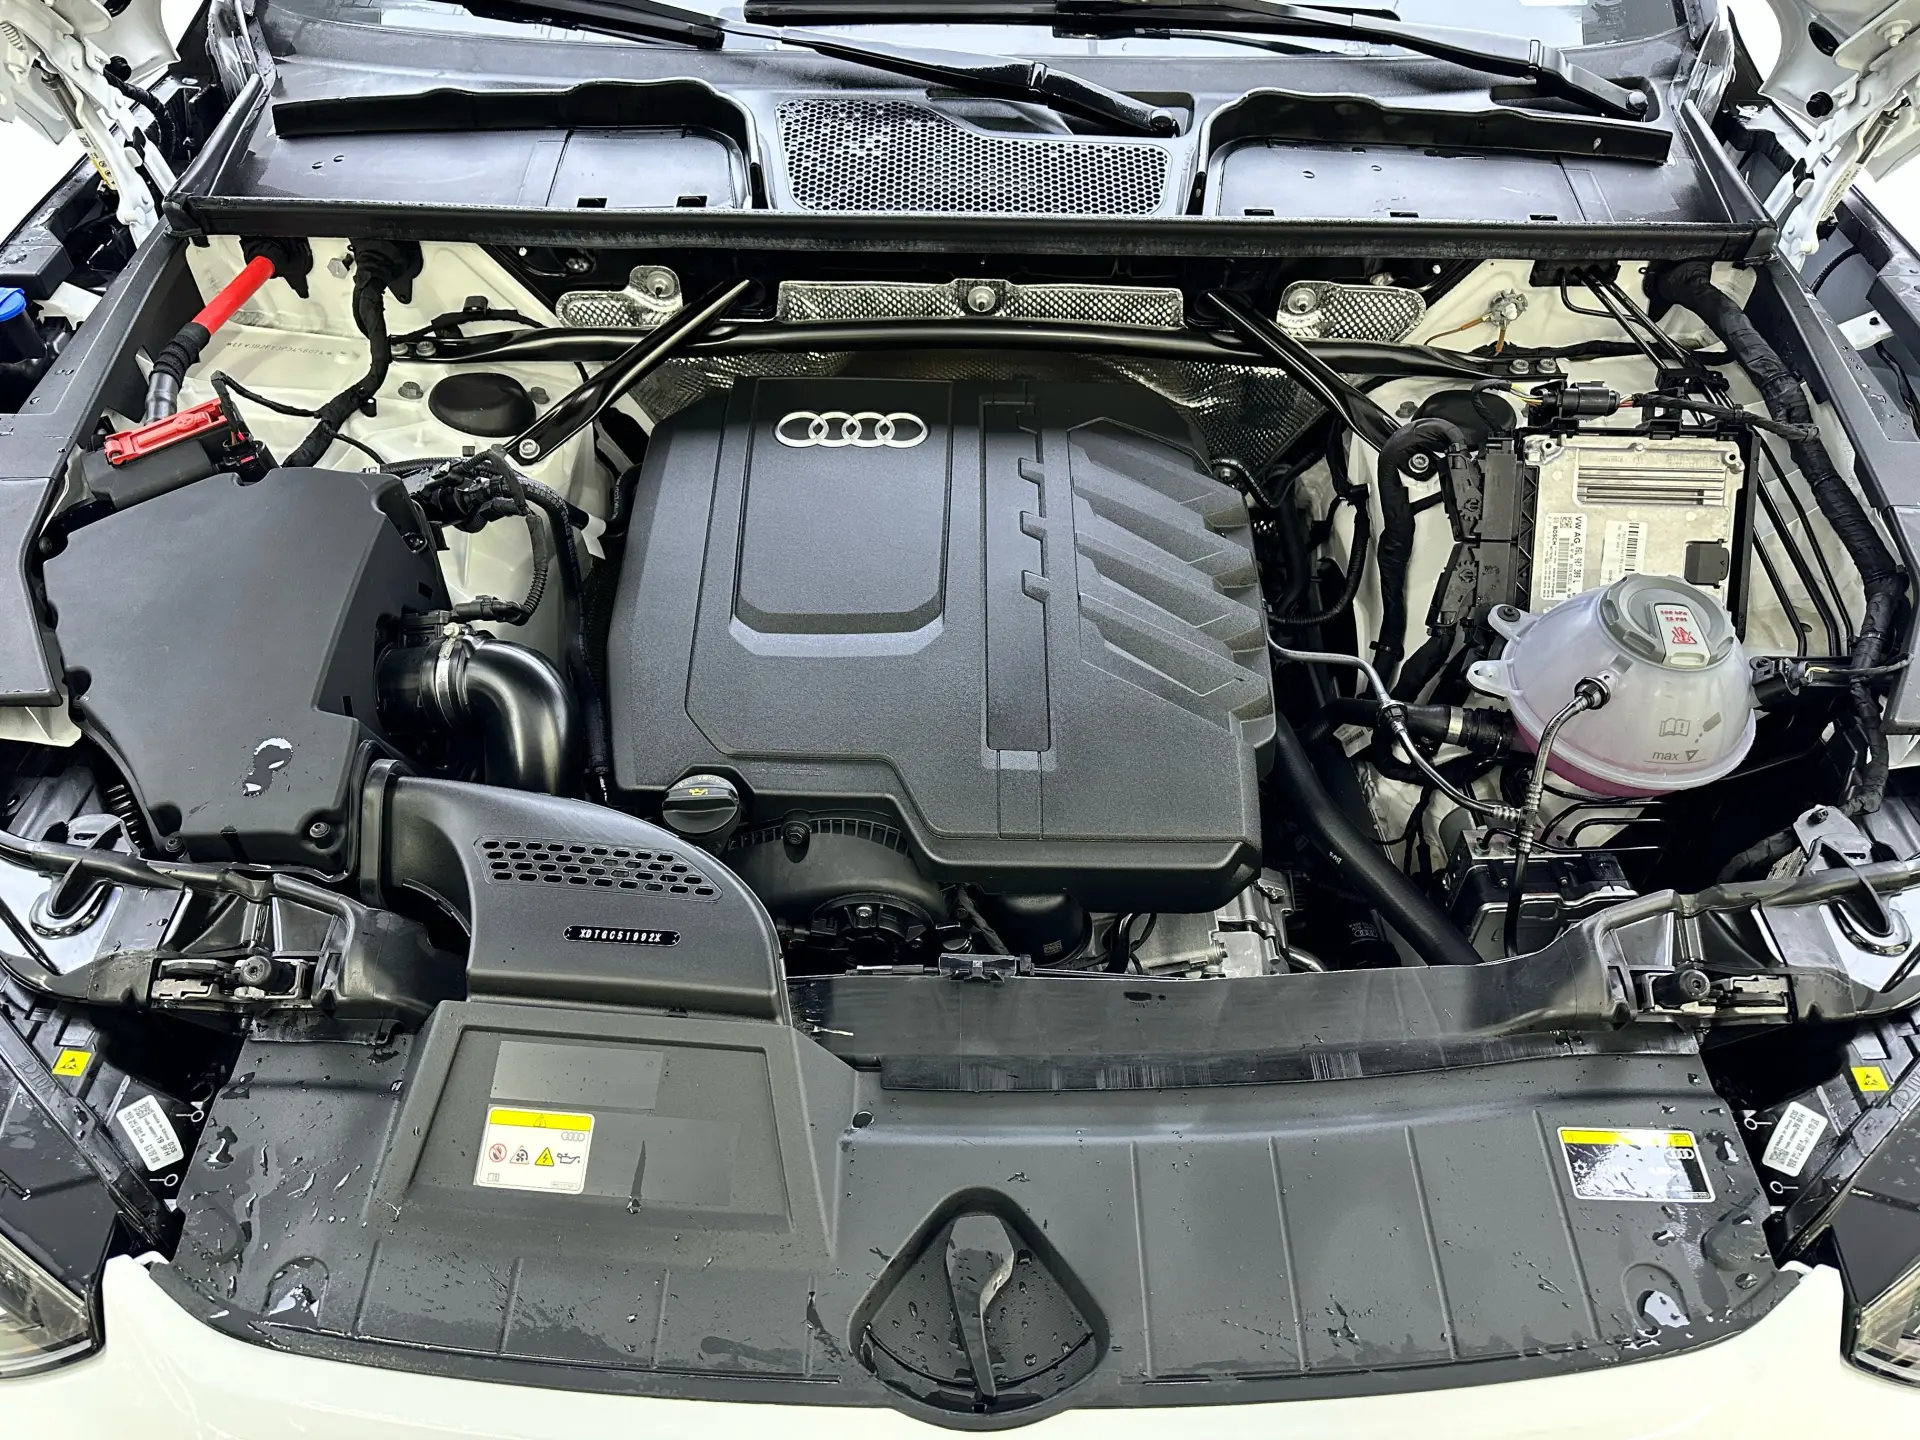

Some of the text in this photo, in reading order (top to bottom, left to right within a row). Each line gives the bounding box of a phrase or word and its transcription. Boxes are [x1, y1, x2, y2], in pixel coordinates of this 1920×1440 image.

[1574, 516, 1582, 530] VW
[1574, 532, 1581, 544] AG
[1652, 752, 1679, 760] max
